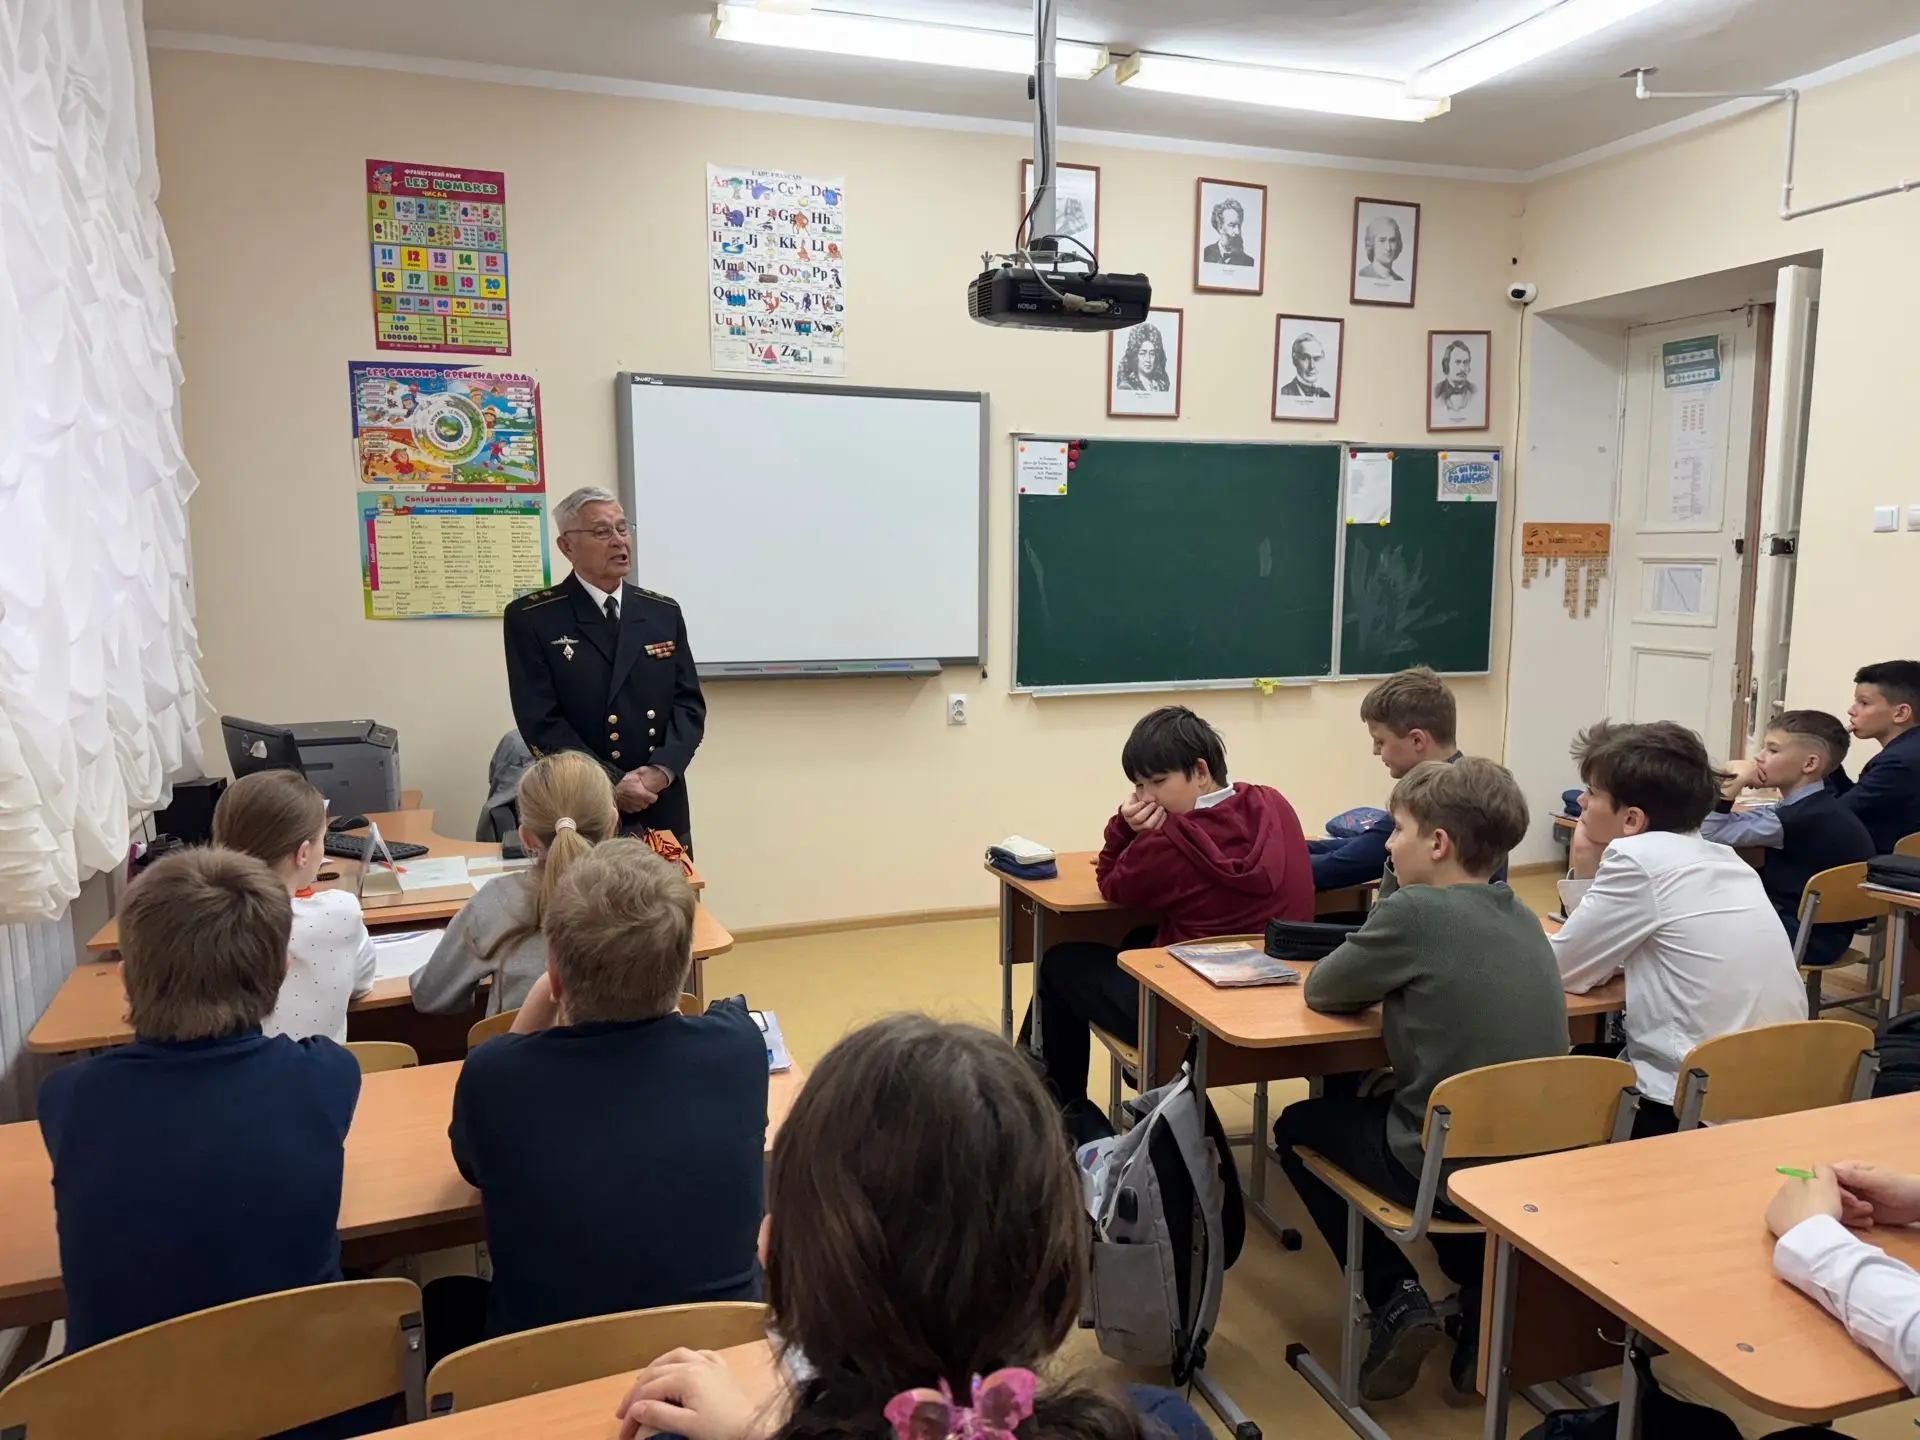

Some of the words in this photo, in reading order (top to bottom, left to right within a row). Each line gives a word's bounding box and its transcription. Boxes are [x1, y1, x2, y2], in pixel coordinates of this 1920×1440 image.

[404, 177, 428, 188] LES
[434, 179, 498, 194] NOMBRES
[711, 176, 728, 187] Aa
[418, 203, 424, 214] 2
[462, 207, 468, 217] 4
[483, 208, 489, 218] 5
[746, 206, 760, 218] Ff
[812, 212, 830, 224] Hh
[375, 223, 382, 233] 6
[484, 231, 496, 241] 10
[712, 231, 722, 242] Ii
[746, 234, 758, 248] Jj
[780, 237, 797, 249] Kk
[382, 248, 392, 260] 11
[408, 250, 420, 261] 12
[434, 252, 446, 263] 13
[459, 254, 472, 265] 14
[486, 256, 497, 267] 15
[713, 259, 738, 270] Mm
[747, 261, 764, 273] Nn
[779, 264, 797, 276] Oo
[812, 267, 828, 281] Pp
[382, 272, 395, 283] 16
[409, 274, 421, 284] 17
[434, 275, 448, 286] 18
[461, 277, 473, 288] 19
[485, 278, 500, 290] 20
[747, 288, 763, 300] Rr
[780, 291, 794, 303] Ss
[456, 301, 466, 309] 70
[492, 303, 502, 311] 90
[715, 314, 732, 326] Uu
[366, 367, 386, 377] LES
[388, 368, 436, 377] SAISONS
[443, 370, 493, 380] ВРЕМЕНА
[500, 373, 528, 382] ГОДА
